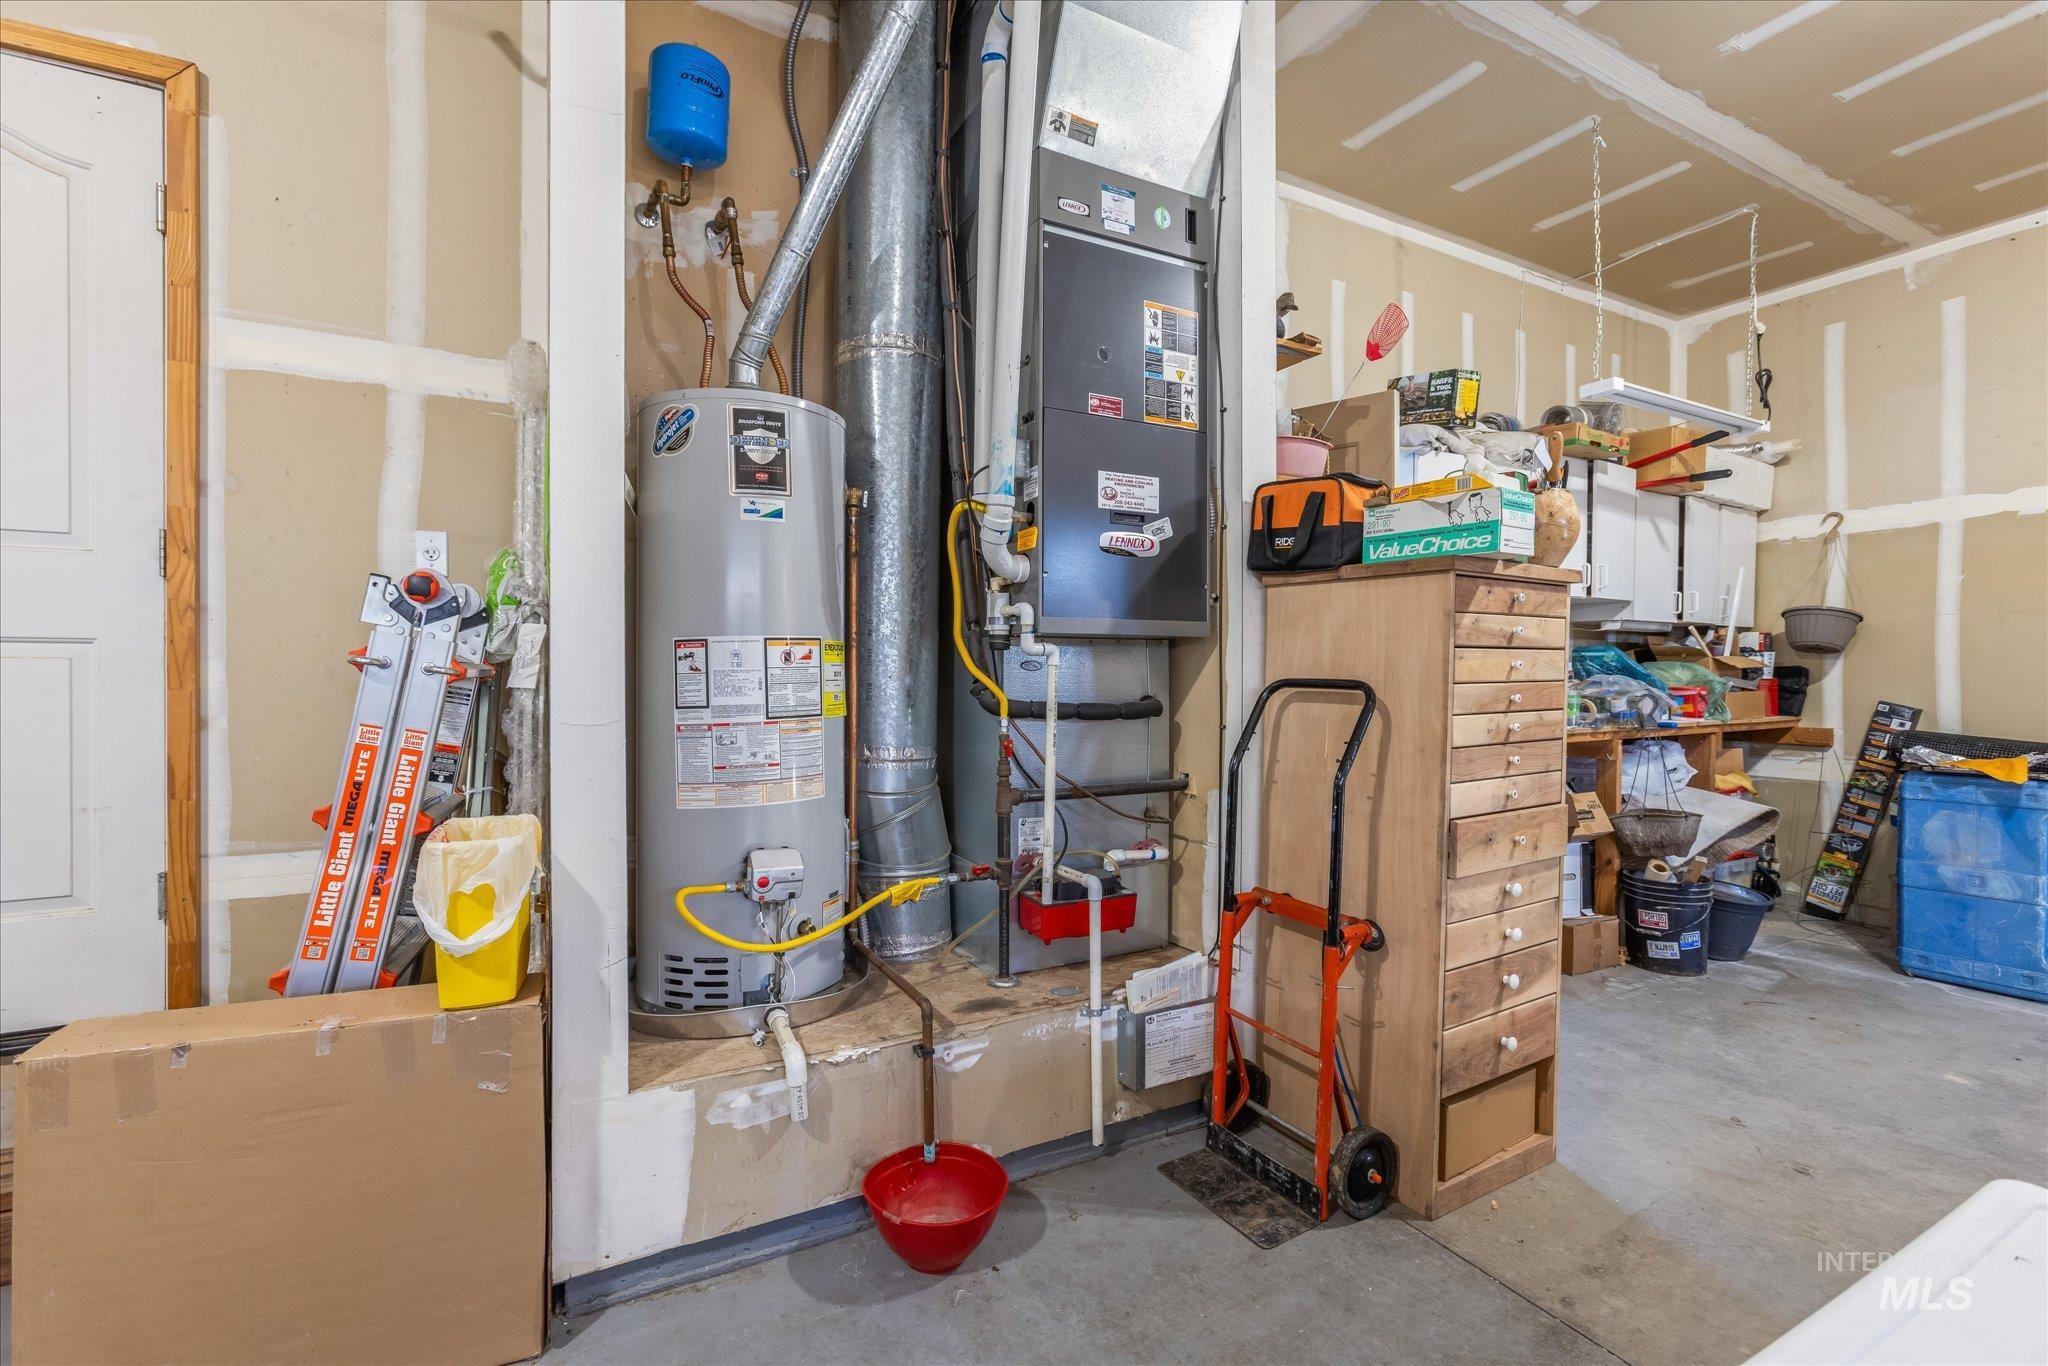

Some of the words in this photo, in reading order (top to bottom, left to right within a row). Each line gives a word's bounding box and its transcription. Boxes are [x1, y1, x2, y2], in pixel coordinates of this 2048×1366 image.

[1062, 201, 1081, 211] LENNOX
[1431, 377, 1454, 385] KNIFE
[729, 434, 790, 449] DEFENDER
[1368, 520, 1391, 530] 291-90
[1109, 536, 1146, 549] LENNOX
[1275, 537, 1295, 546] RIDG
[1369, 533, 1492, 560] ValueChoice
[360, 728, 380, 736] Little
[405, 733, 425, 741] Little
[359, 734, 379, 742] Giant
[404, 739, 423, 747] Giant
[392, 754, 418, 798] Little
[380, 802, 406, 846] Giant
[314, 881, 342, 928] Little
[328, 831, 354, 876] Giant
[1812, 888, 1842, 903] ELEVATED
[1830, 887, 1844, 896] PET
